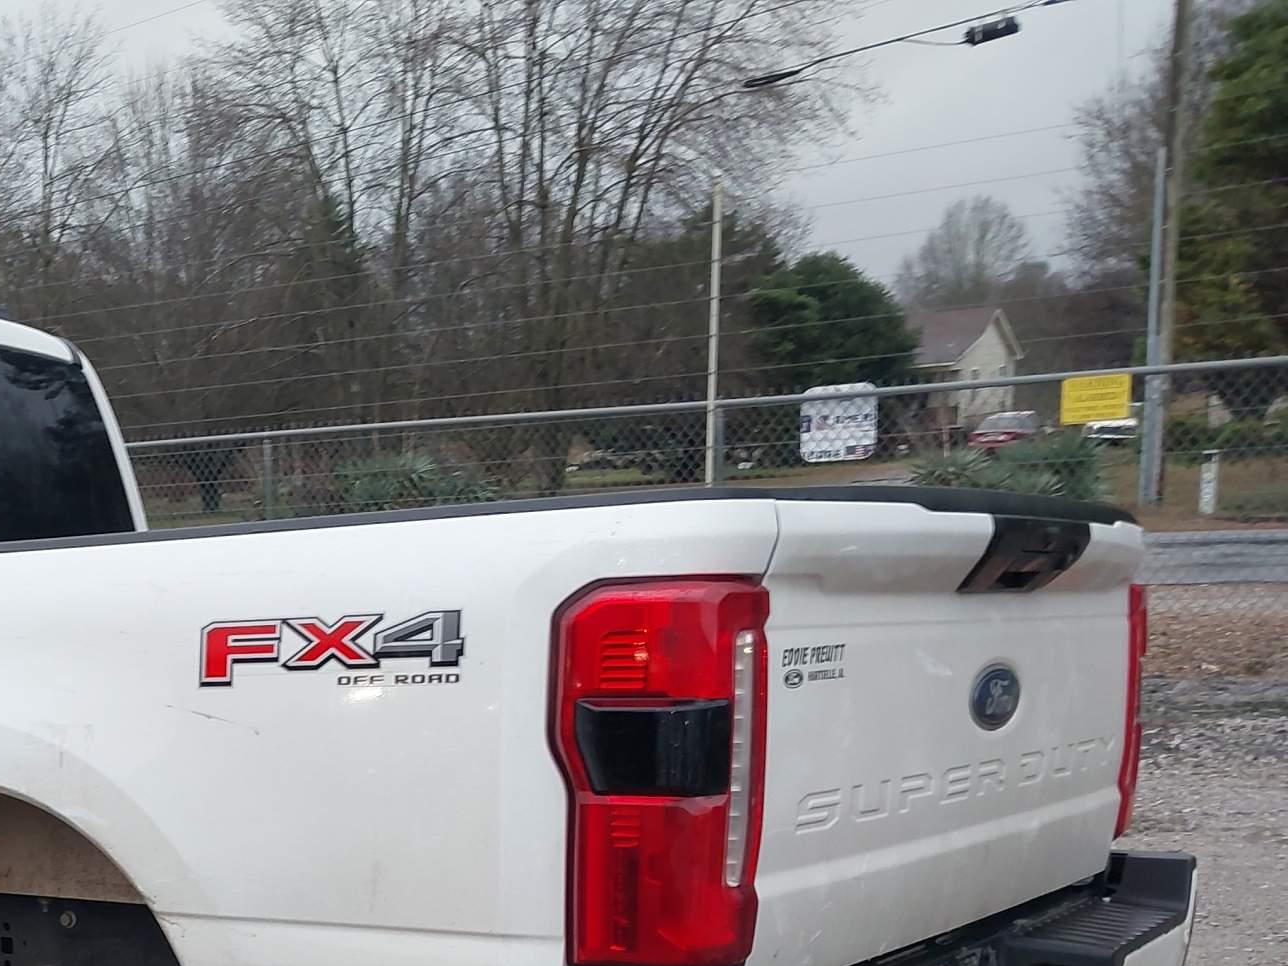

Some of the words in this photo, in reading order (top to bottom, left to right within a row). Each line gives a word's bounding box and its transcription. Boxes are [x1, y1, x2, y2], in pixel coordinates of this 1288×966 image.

[199, 609, 464, 688] FX4
[782, 647, 810, 667] EDDIE
[337, 674, 384, 686] OFF
[394, 673, 460, 685] ROAD
[795, 758, 1008, 836] SUPER
[1017, 736, 1116, 788] DUTY
